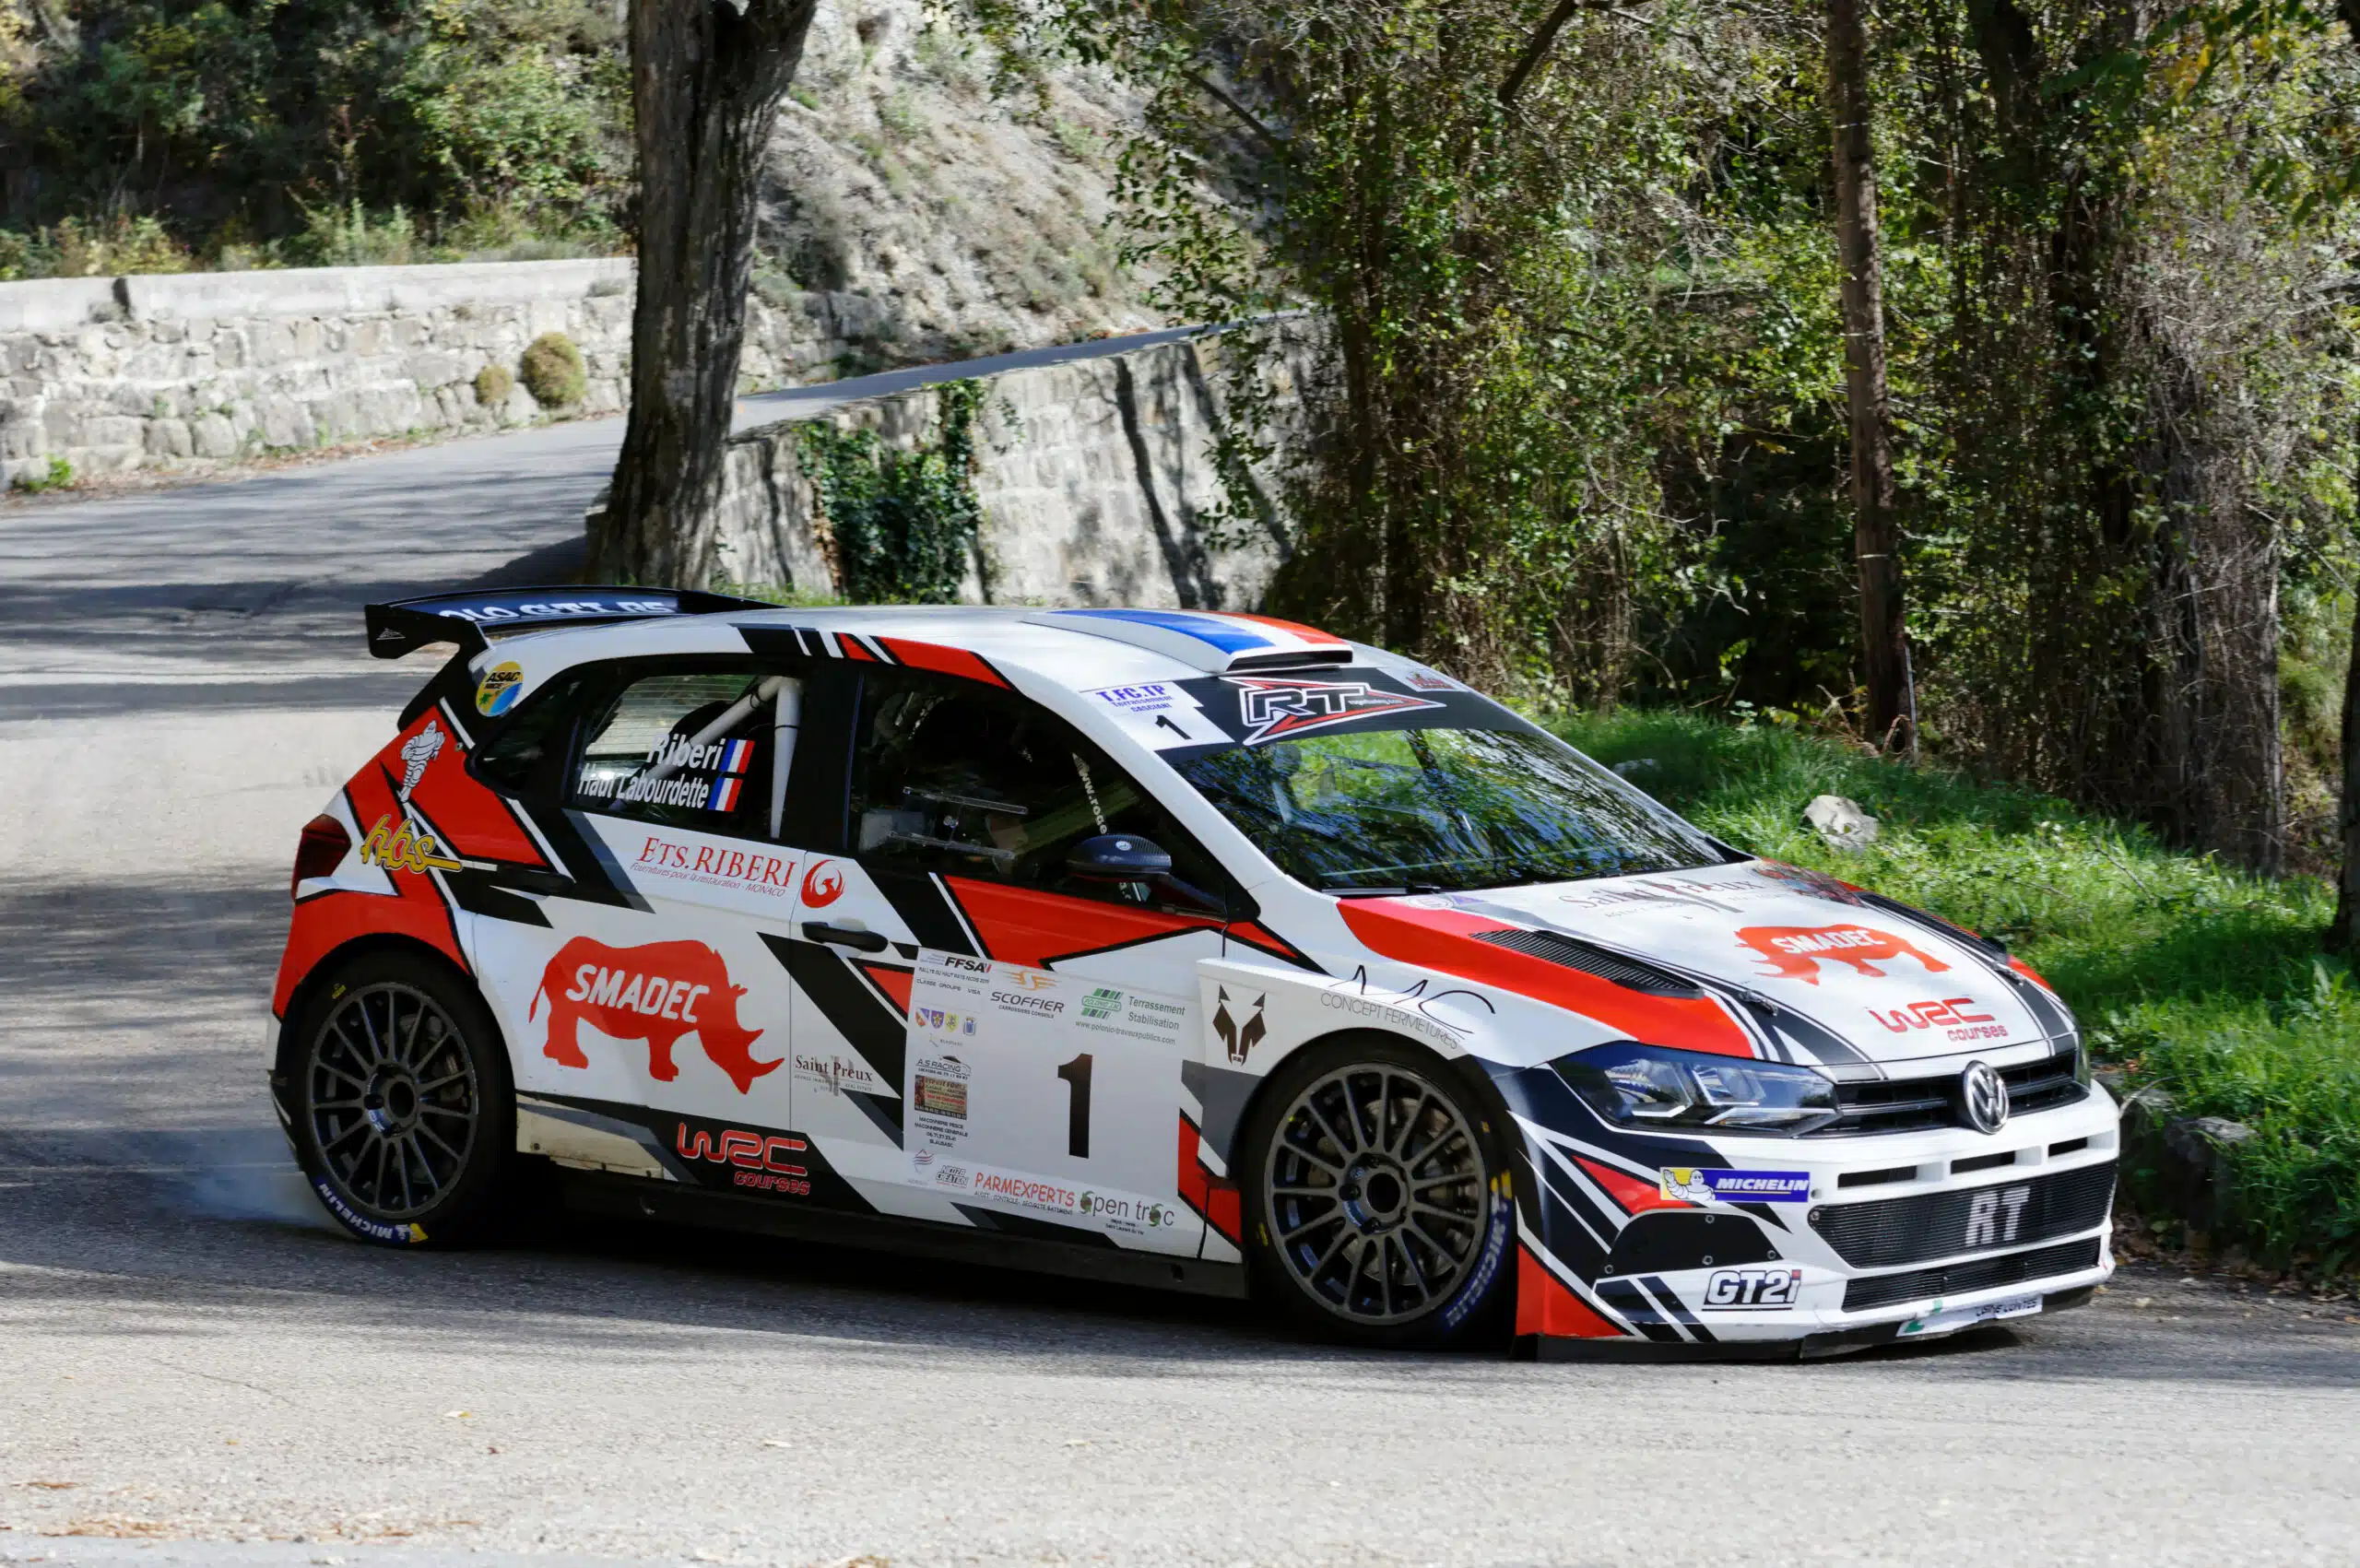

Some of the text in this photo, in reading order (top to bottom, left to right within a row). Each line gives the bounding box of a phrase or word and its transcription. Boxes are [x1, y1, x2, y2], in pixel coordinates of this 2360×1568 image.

[520, 602, 609, 615] GTI
[486, 671, 522, 682] ASAC
[1241, 686, 1365, 725] RT
[1155, 715, 1192, 740] 1
[646, 732, 726, 771] Riberi
[577, 763, 710, 809] Haut Labourdette
[630, 862, 670, 876] Fournitures
[668, 869, 691, 880] pour
[697, 874, 739, 890] restauration
[746, 883, 785, 897] MONACO
[1771, 929, 1887, 954] SMADEC
[945, 956, 985, 973] FFSA
[565, 963, 710, 1023] SMADEC
[916, 978, 981, 996] CLASSE GROUPE VISA
[990, 991, 1065, 1013] SCOFFIER
[1128, 996, 1186, 1016] Terrassement
[1128, 1011, 1180, 1031] Stabilisation
[1321, 992, 1458, 1050] CONCEPT FERMETURES
[1867, 997, 1996, 1033] WRC
[1947, 1025, 2009, 1042] courses
[796, 1055, 828, 1074] Saint
[833, 1061, 873, 1082] Preux
[931, 1061, 962, 1072] RACING
[1057, 1053, 1093, 1159] 1
[678, 1122, 808, 1175] WRC
[734, 1171, 810, 1196] courses
[936, 1173, 969, 1186] CREATION
[975, 1172, 1076, 1208] PARMEXPERTS
[1716, 1178, 1810, 1191] MICHELIN
[319, 1183, 394, 1240] MICHELIN
[1965, 1186, 2031, 1247] RT
